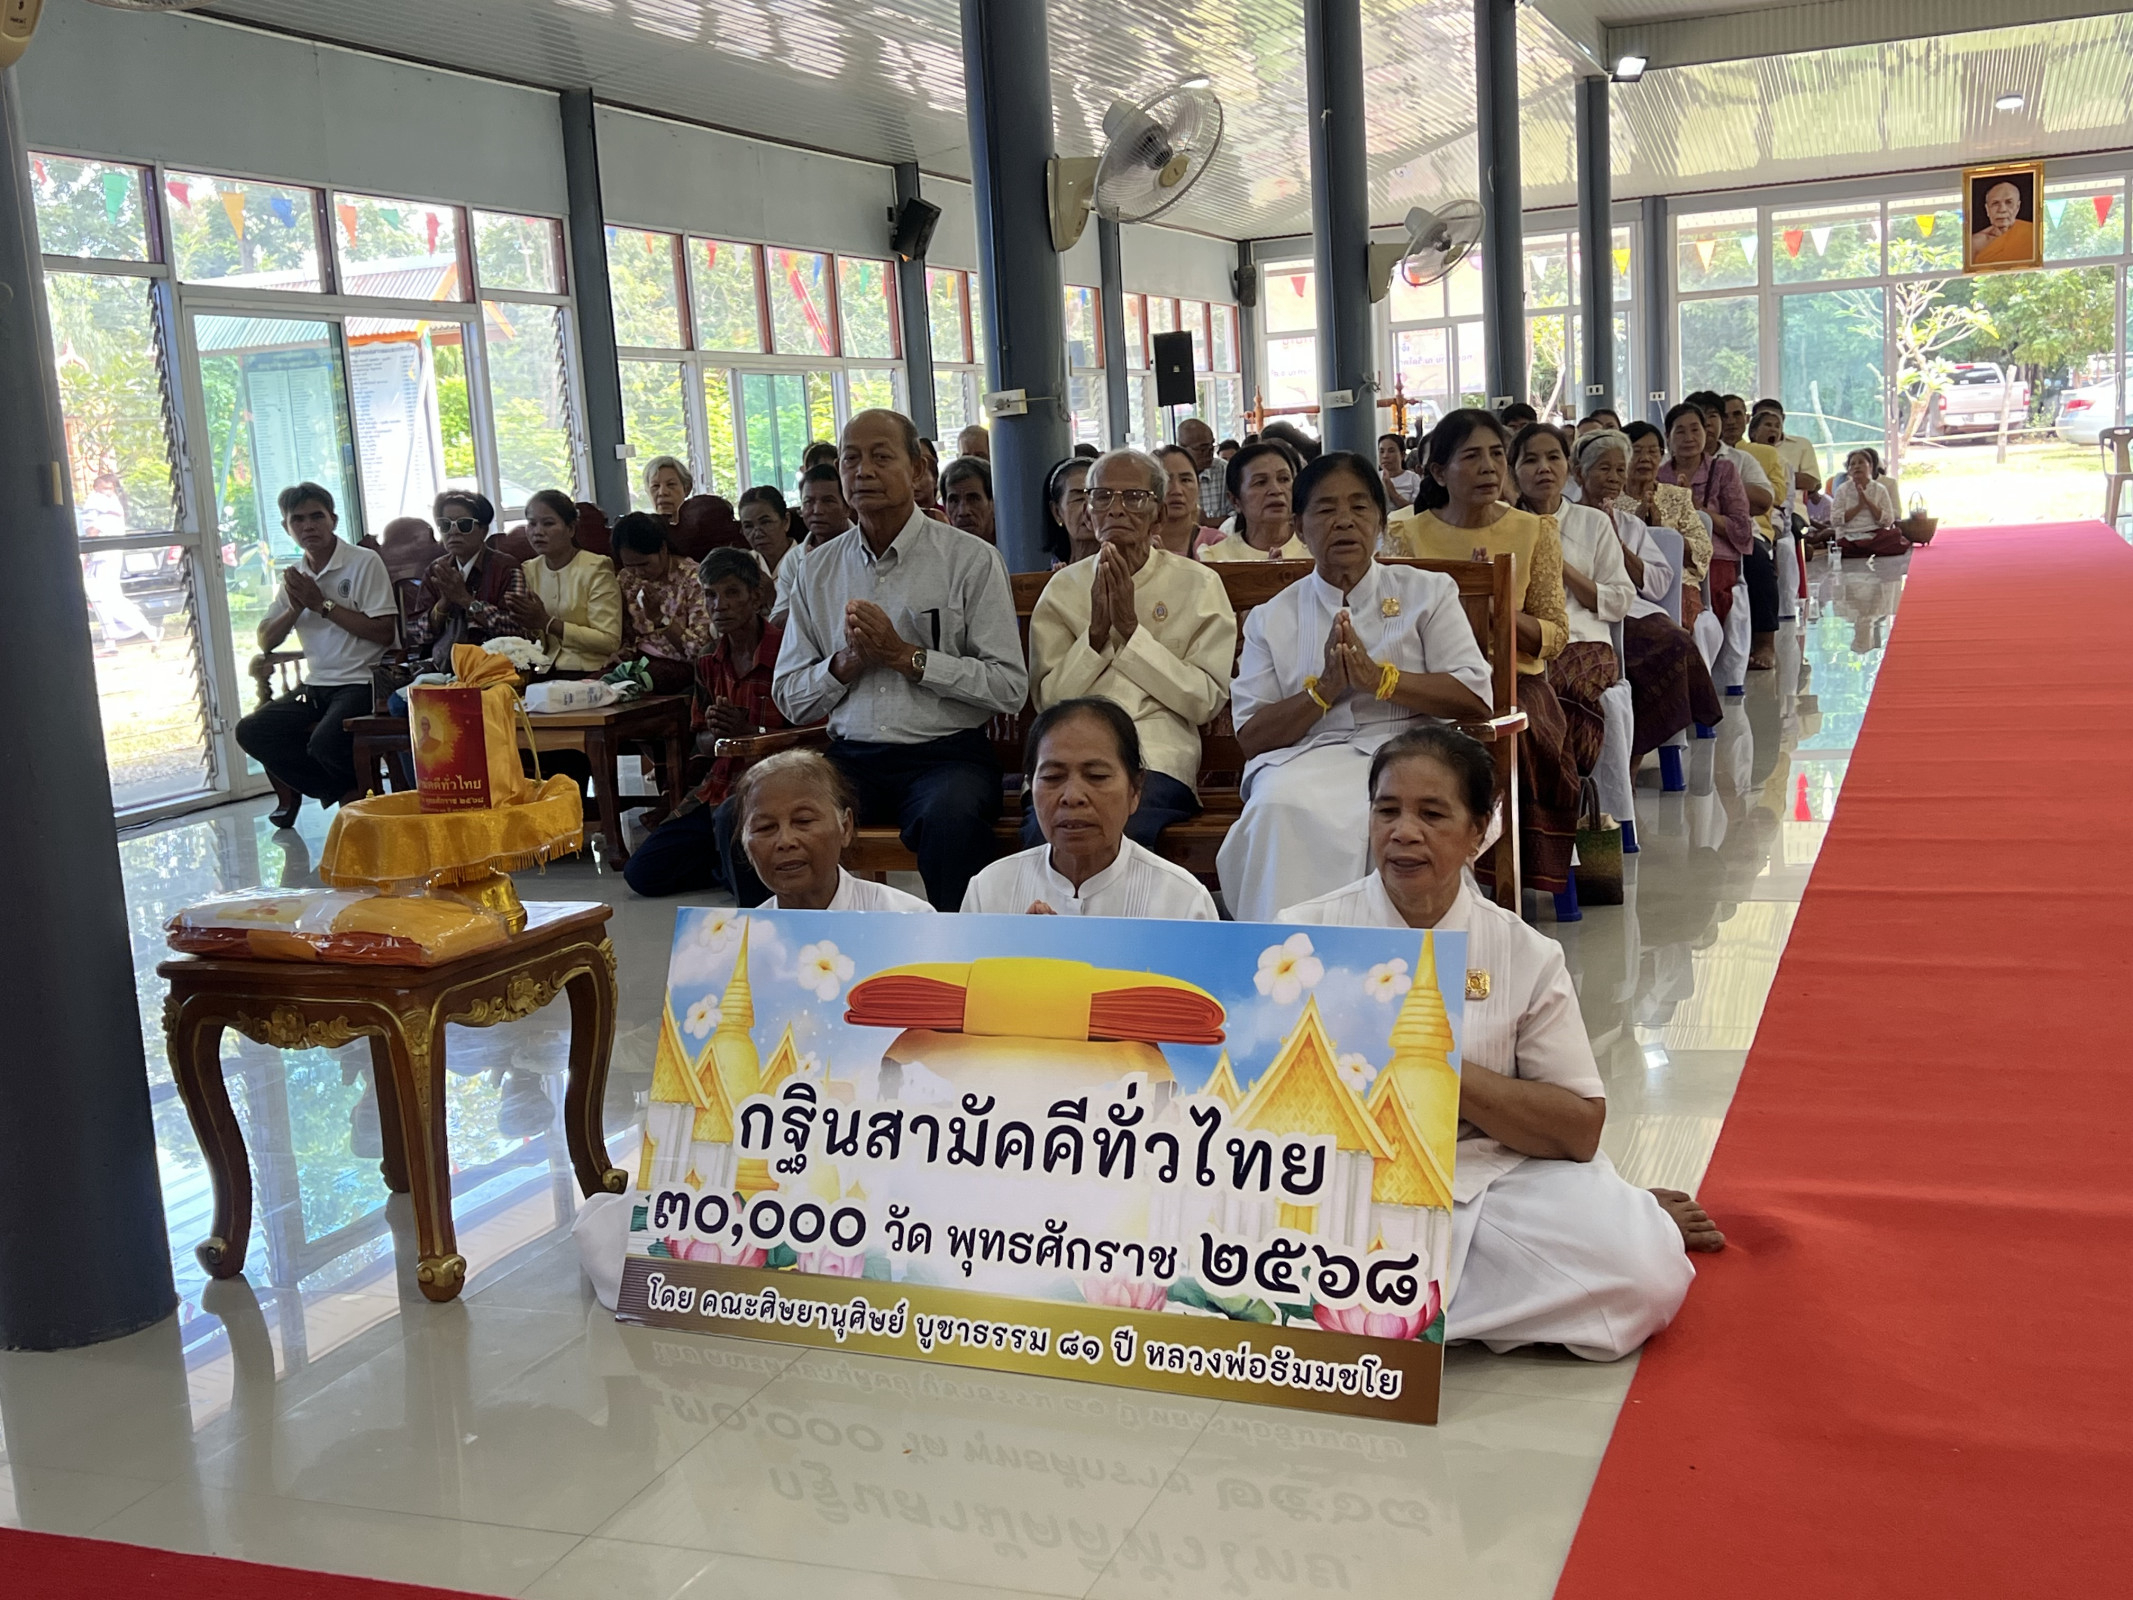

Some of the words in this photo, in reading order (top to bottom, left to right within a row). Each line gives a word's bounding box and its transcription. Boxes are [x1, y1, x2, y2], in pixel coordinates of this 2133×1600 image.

[740, 1081, 1326, 1196] กฐินสามัคคีทั่วไทย
[653, 1190, 867, 1248] ๓๐,๐๐๐
[884, 1204, 932, 1255] วัด
[947, 1218, 1178, 1281] พุทธศักราช
[1200, 1232, 1420, 1306] ๒๕๖๘
[649, 1276, 693, 1310] โดย
[702, 1290, 906, 1339] คณะศิษยานุศิษย์
[916, 1315, 1048, 1353] บูชาธรรม
[1059, 1333, 1100, 1361] ๘๑
[1113, 1330, 1134, 1362] ปี
[1146, 1344, 1399, 1396] หลวงพ่อธัมมชโย
